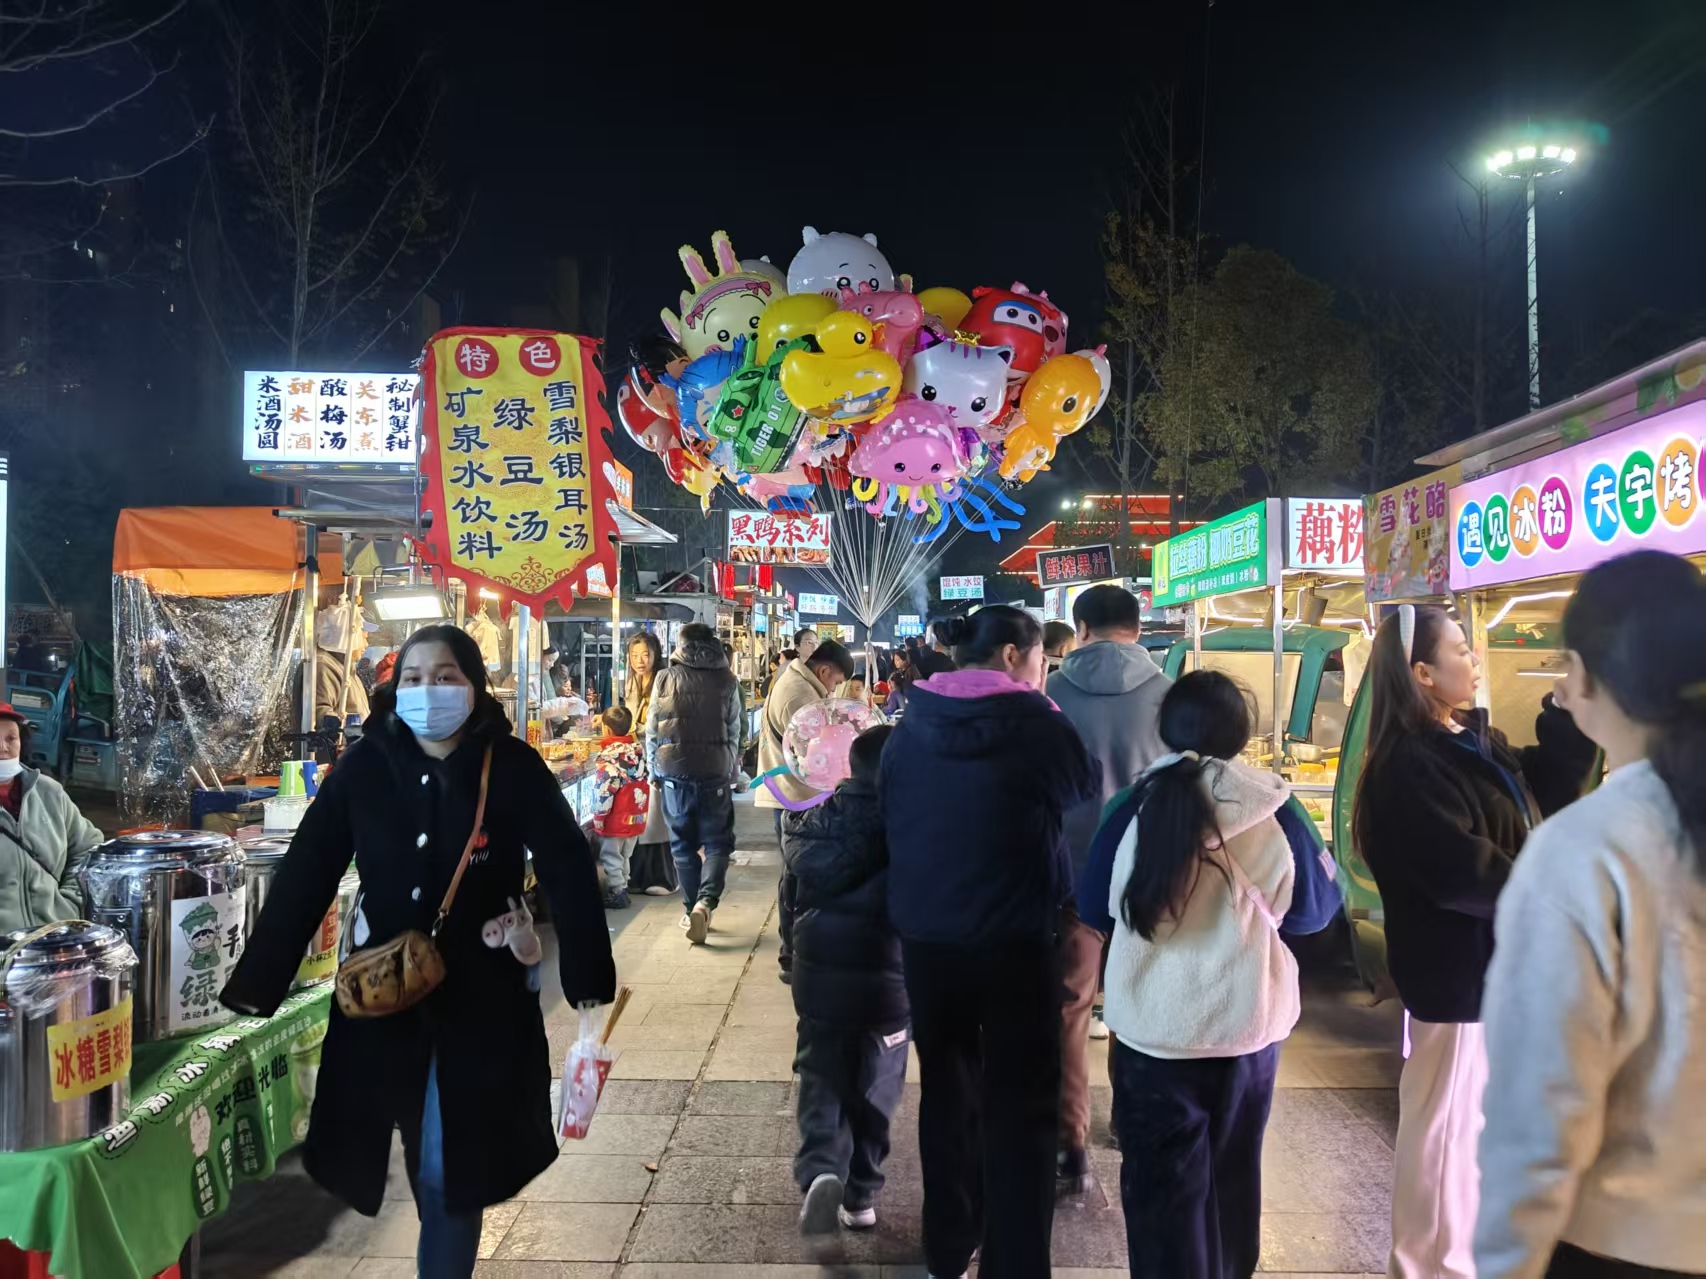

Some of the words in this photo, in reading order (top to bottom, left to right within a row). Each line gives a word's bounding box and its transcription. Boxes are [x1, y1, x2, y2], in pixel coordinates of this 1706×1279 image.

[460, 341, 556, 372] 特色
[255, 375, 283, 450] 米酒汤圆
[287, 376, 315, 450] 甜米酒
[320, 378, 348, 449] 酸梅汤
[354, 379, 380, 452] 关东煮
[385, 377, 414, 452] 秘制蟹钳
[751, 422, 774, 457] TIGER
[445, 386, 503, 561] 矿泉水饮料
[493, 398, 550, 543] 绿豆汤
[543, 380, 590, 551] 雪梨银耳汤
[730, 513, 831, 547] 黑鸭系列
[1380, 479, 1447, 533] 雪花酪
[1462, 487, 1567, 556] 遇见冰粉
[1045, 551, 1108, 580] 鲜榨果汁
[214, 1053, 289, 1126] 欢迎光临
